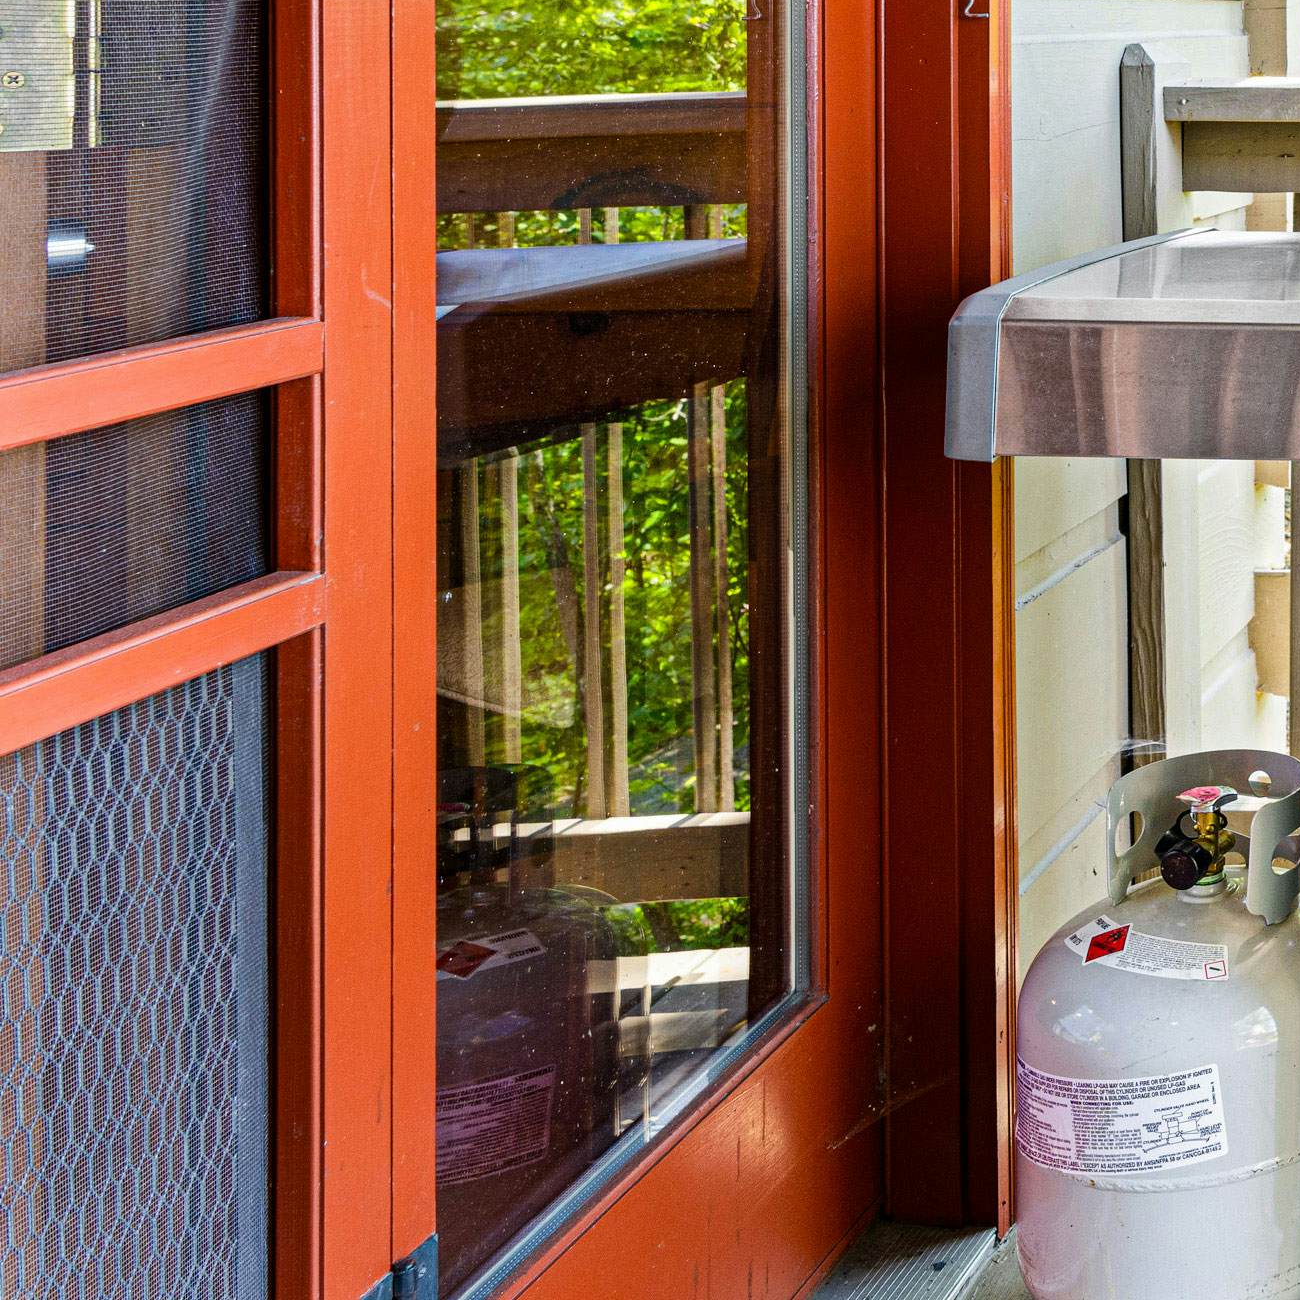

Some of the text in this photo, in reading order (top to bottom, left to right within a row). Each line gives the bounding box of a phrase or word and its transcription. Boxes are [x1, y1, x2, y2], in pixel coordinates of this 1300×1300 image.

[1159, 1074, 1187, 1084] EXPLOSION
[1193, 1068, 1213, 1077] IGNITED
[1160, 1088, 1186, 1096] ENCLOSED
